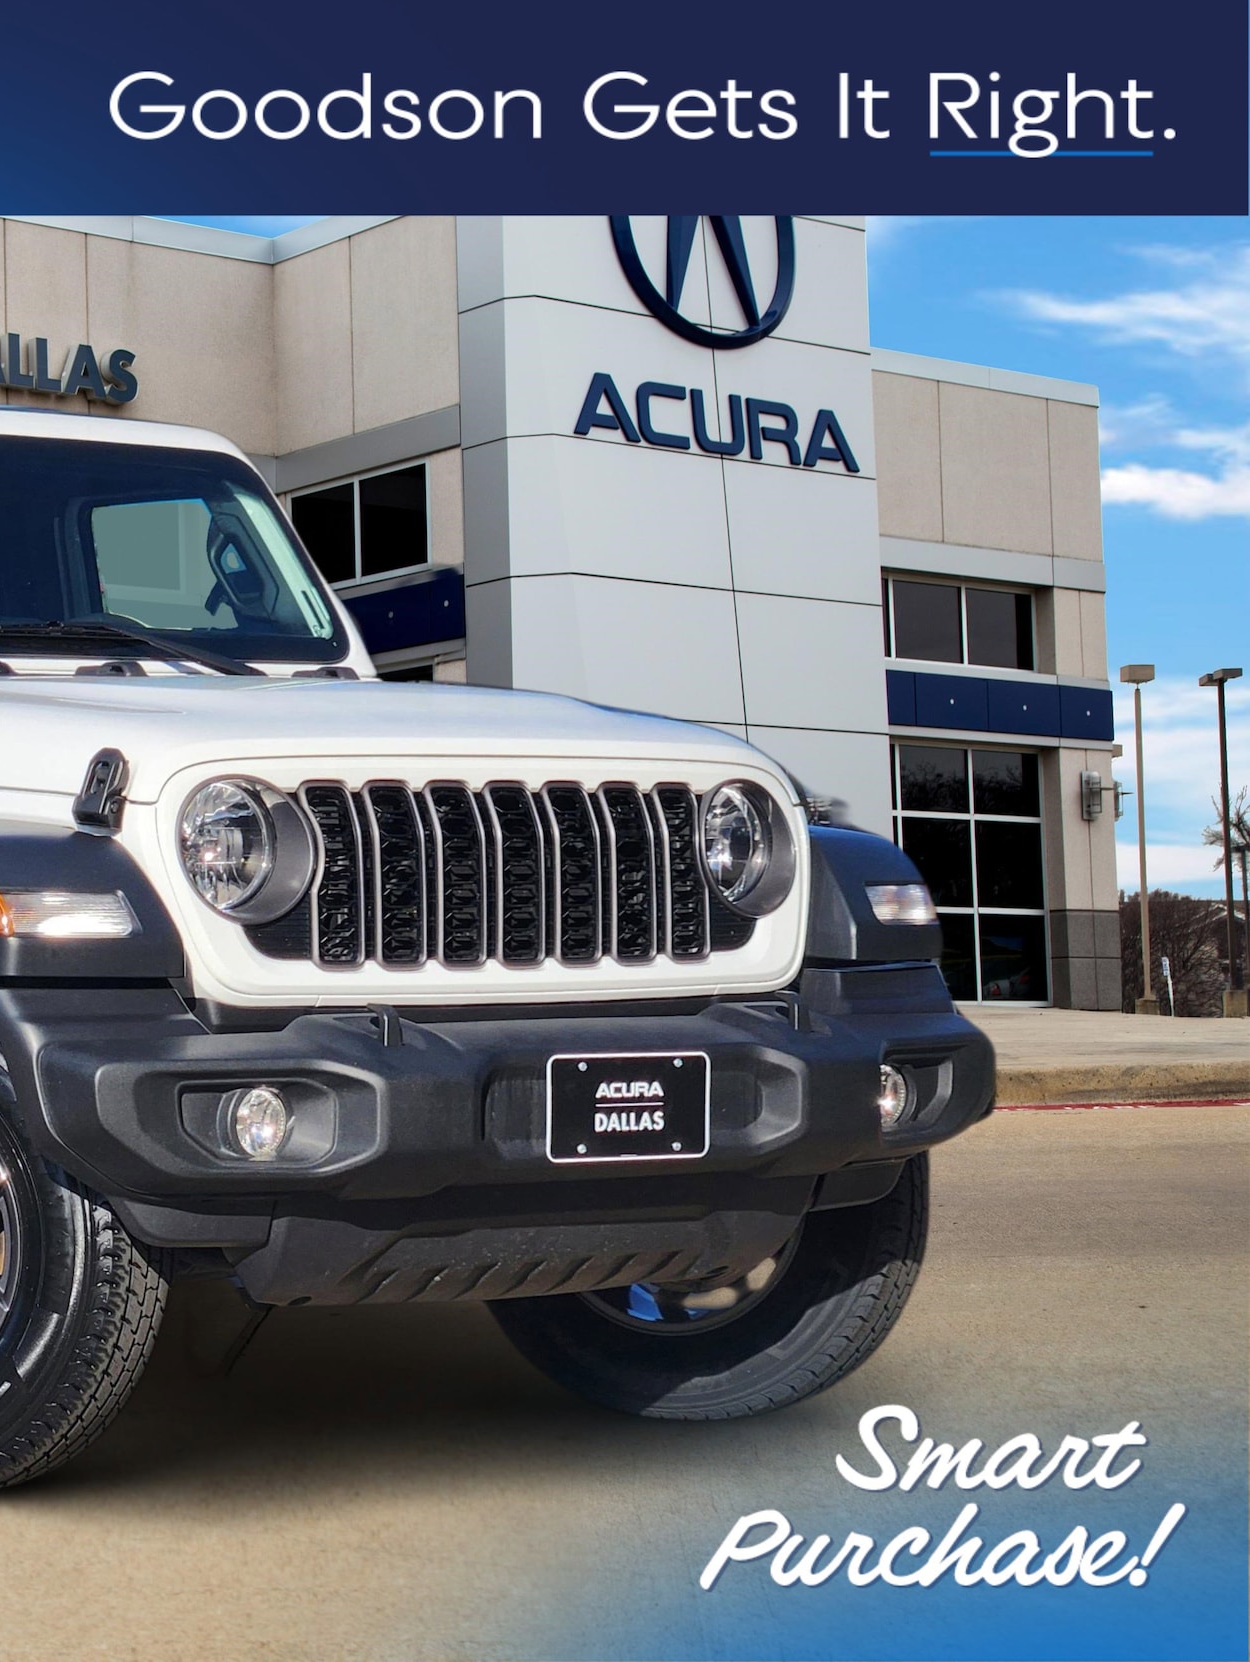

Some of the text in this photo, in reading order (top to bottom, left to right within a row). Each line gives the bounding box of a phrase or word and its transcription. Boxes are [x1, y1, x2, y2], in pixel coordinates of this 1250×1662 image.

[573, 372, 859, 473] ACURA
[595, 1081, 665, 1098] ACURA
[594, 1111, 665, 1132] DALLAS
